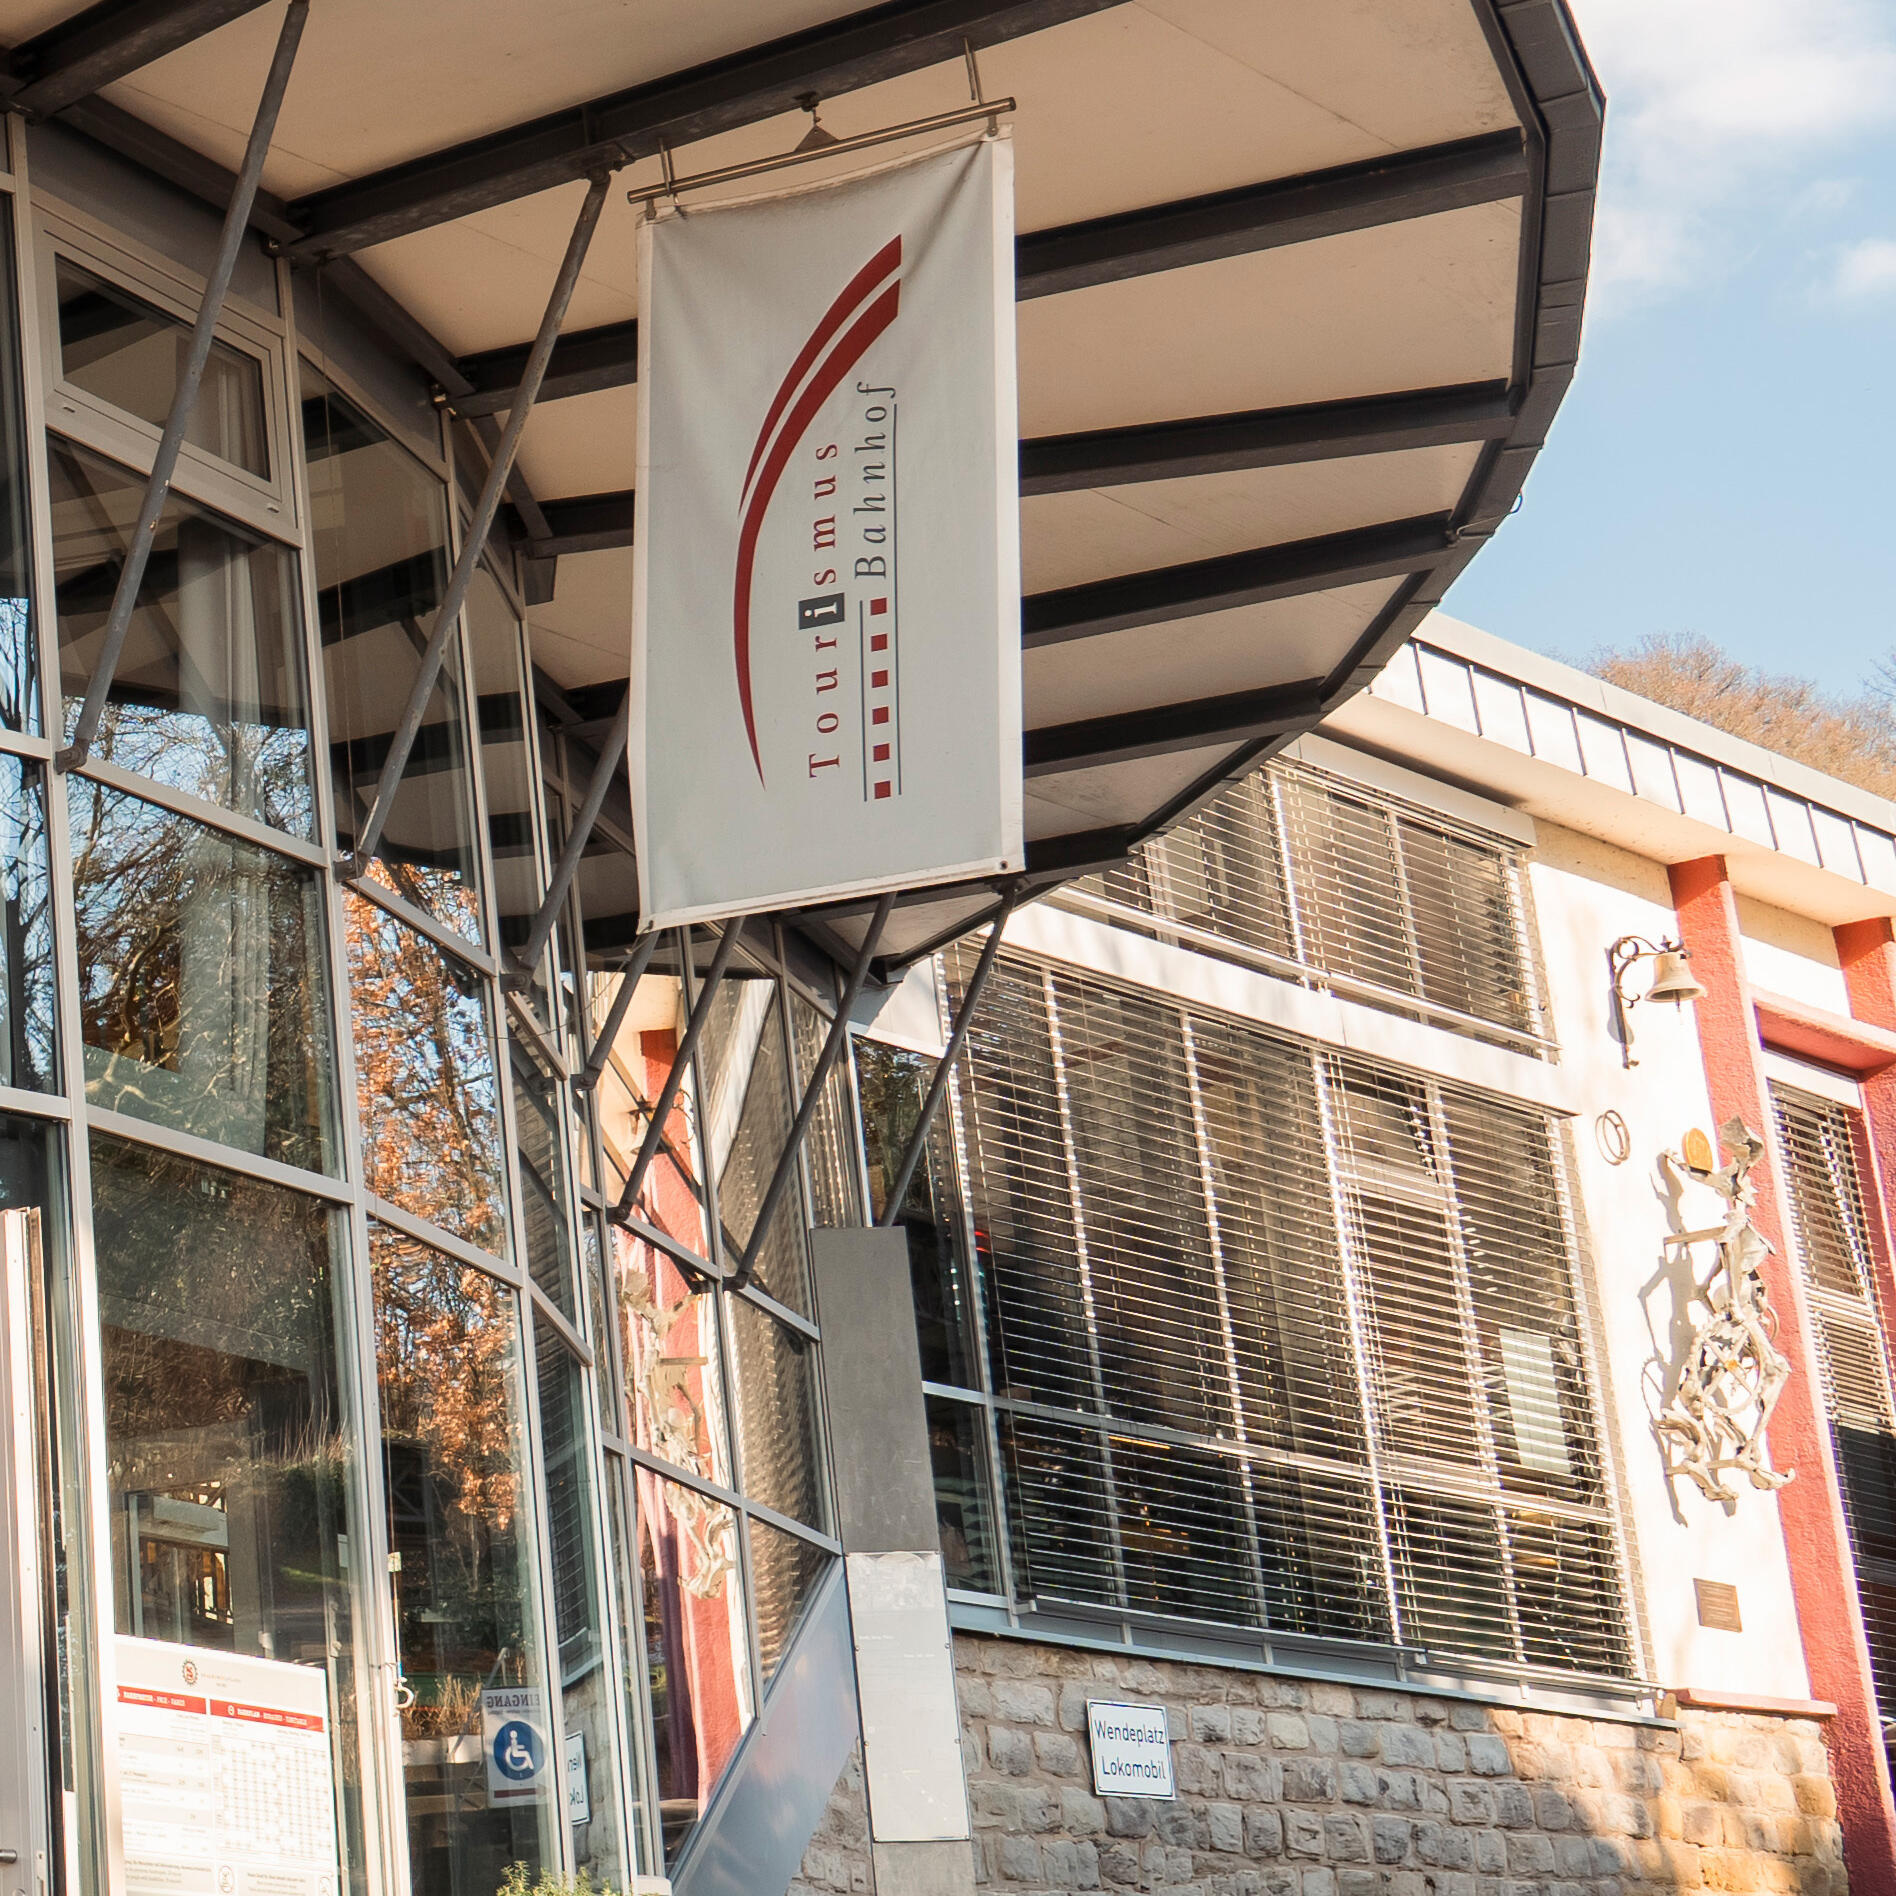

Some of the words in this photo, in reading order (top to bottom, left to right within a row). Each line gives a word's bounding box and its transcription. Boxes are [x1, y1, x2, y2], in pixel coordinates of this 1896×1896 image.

[854, 381, 897, 580] Bahnhof
[804, 443, 843, 779] Tourismus
[1094, 1719, 1165, 1748] Wendeplatz
[1101, 1755, 1167, 1780] Lokomobil
